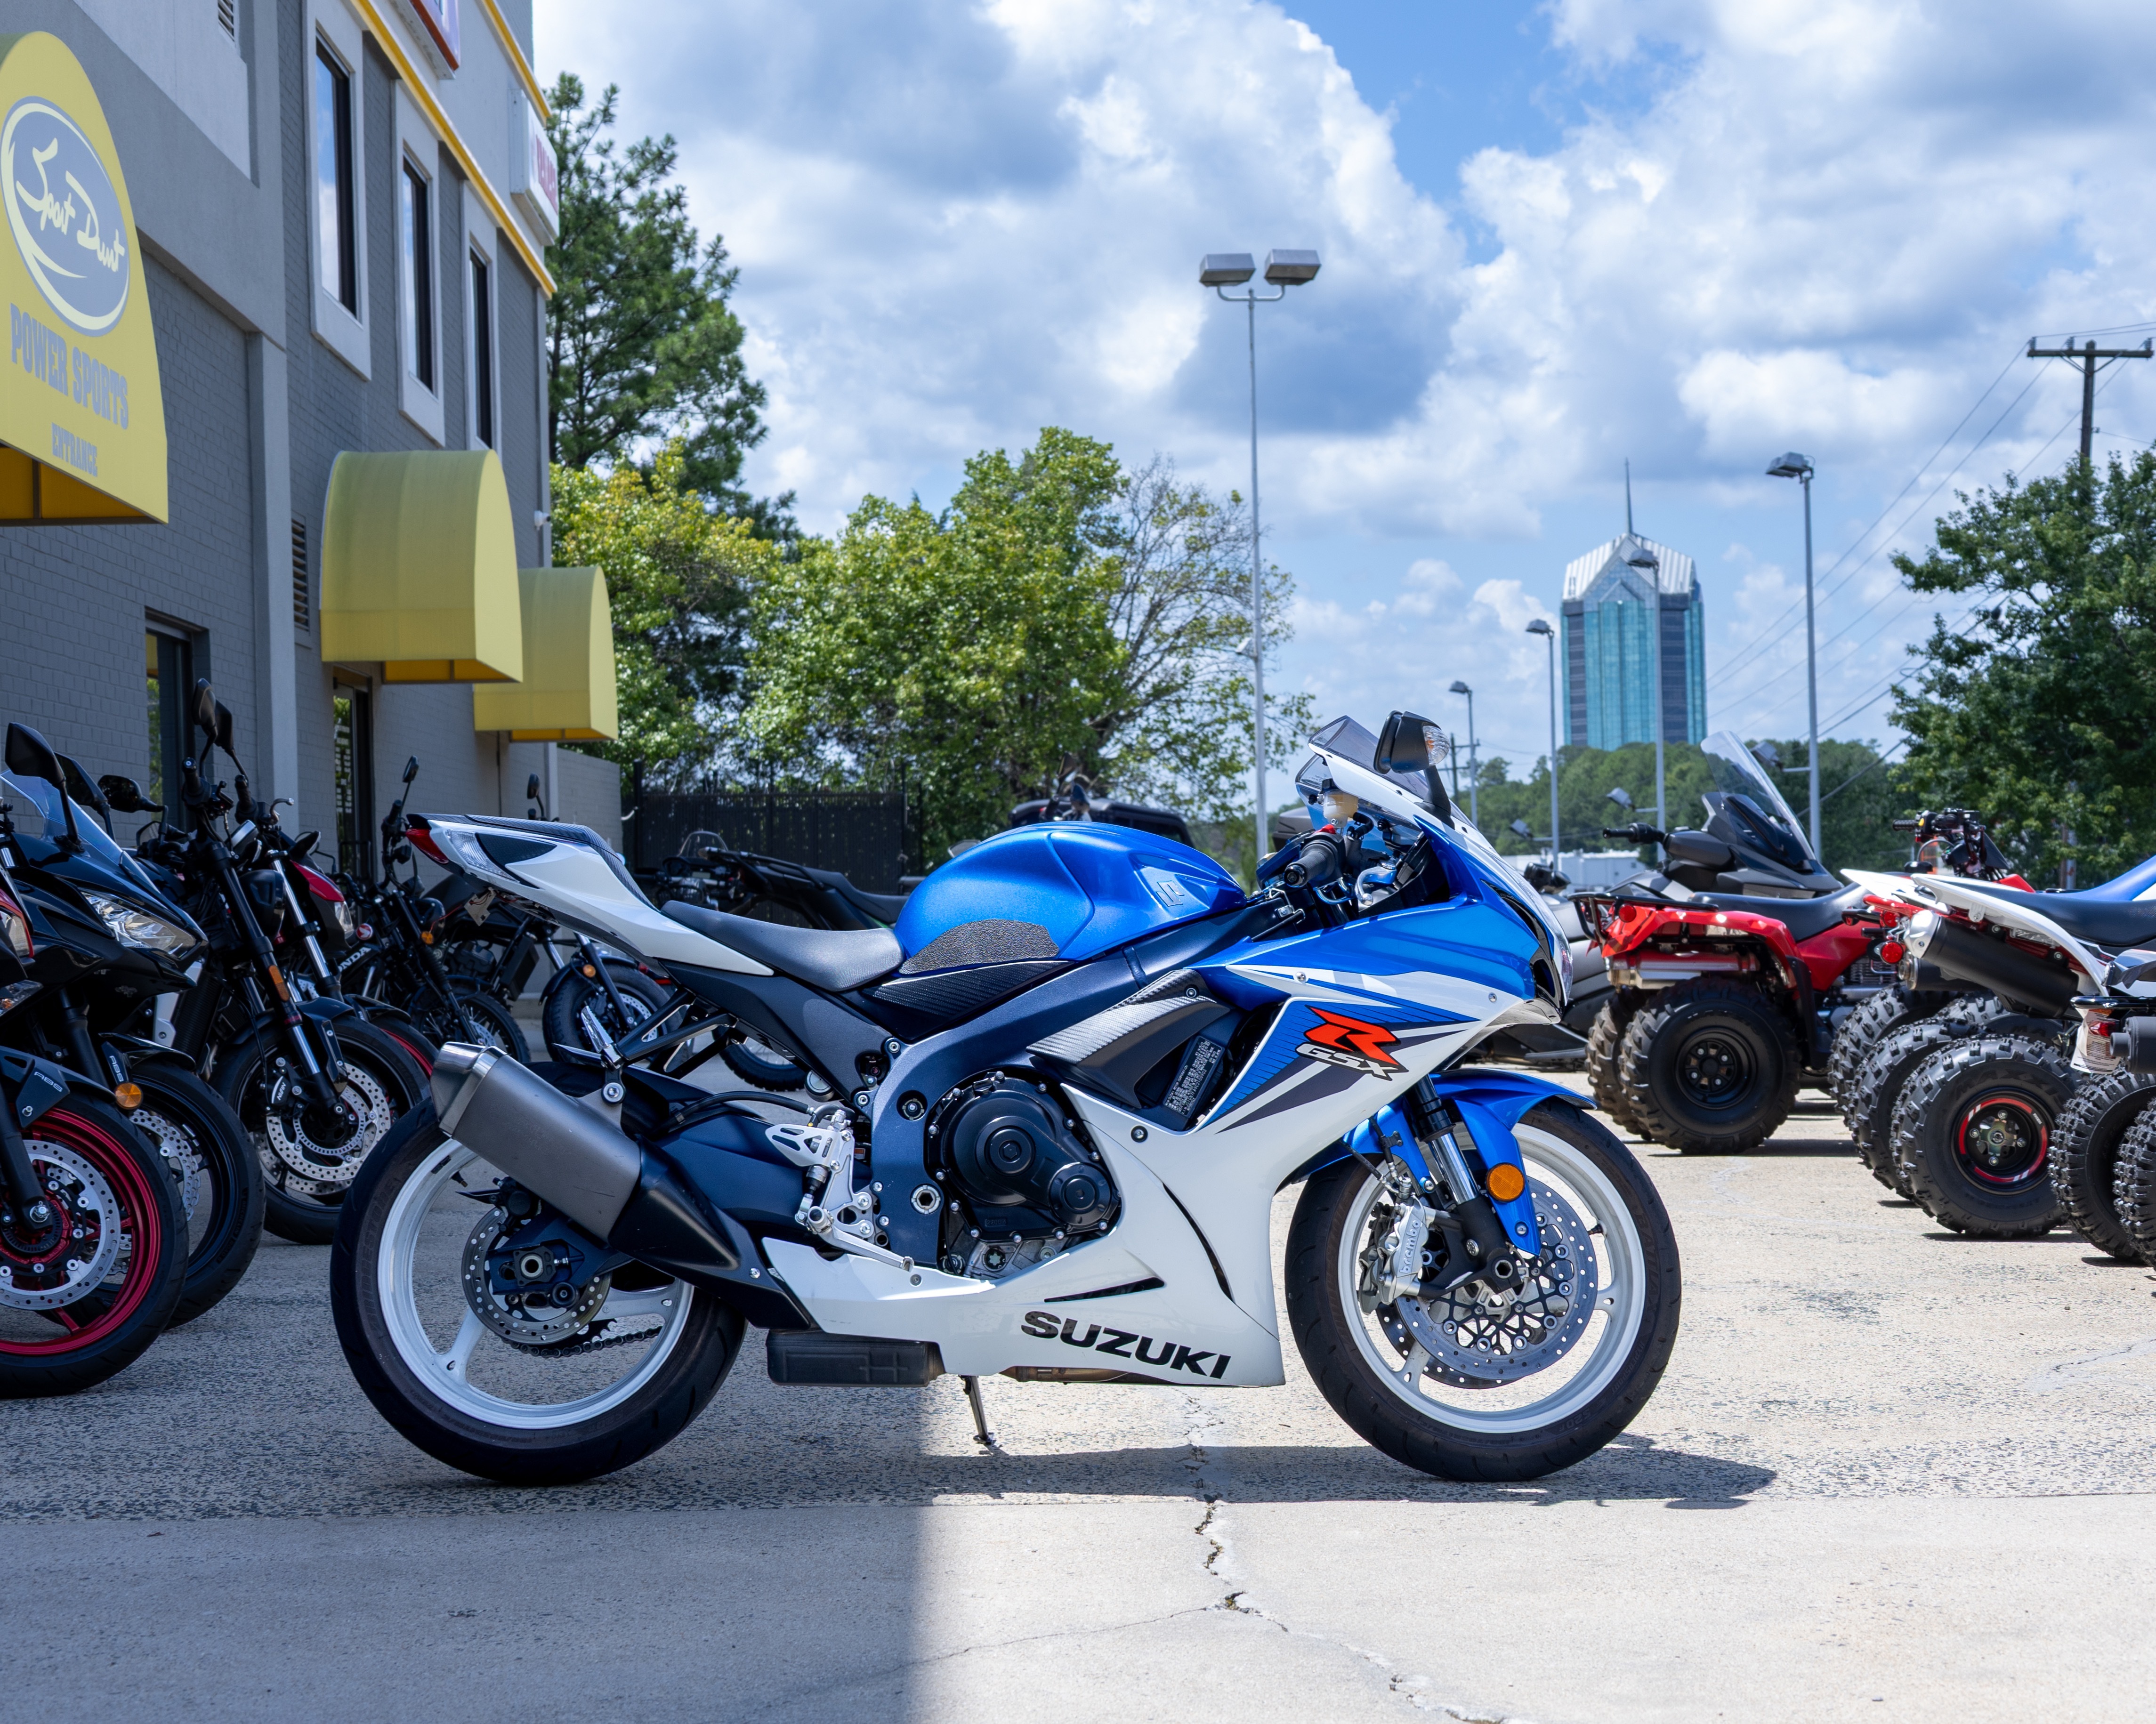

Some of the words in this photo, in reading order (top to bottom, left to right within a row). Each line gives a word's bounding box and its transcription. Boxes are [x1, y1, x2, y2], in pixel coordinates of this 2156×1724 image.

[10, 302, 68, 396] POWER
[72, 346, 129, 430] SPORTS
[52, 422, 97, 477] ENTRANCE
[338, 947, 371, 972] NDA
[34, 1071, 63, 1092] ABS
[109, 1055, 124, 1082] ABS
[1296, 1043, 1398, 1077] GSX
[1399, 1220, 1421, 1273] brembo
[1021, 1311, 1231, 1379] SUZUKI
